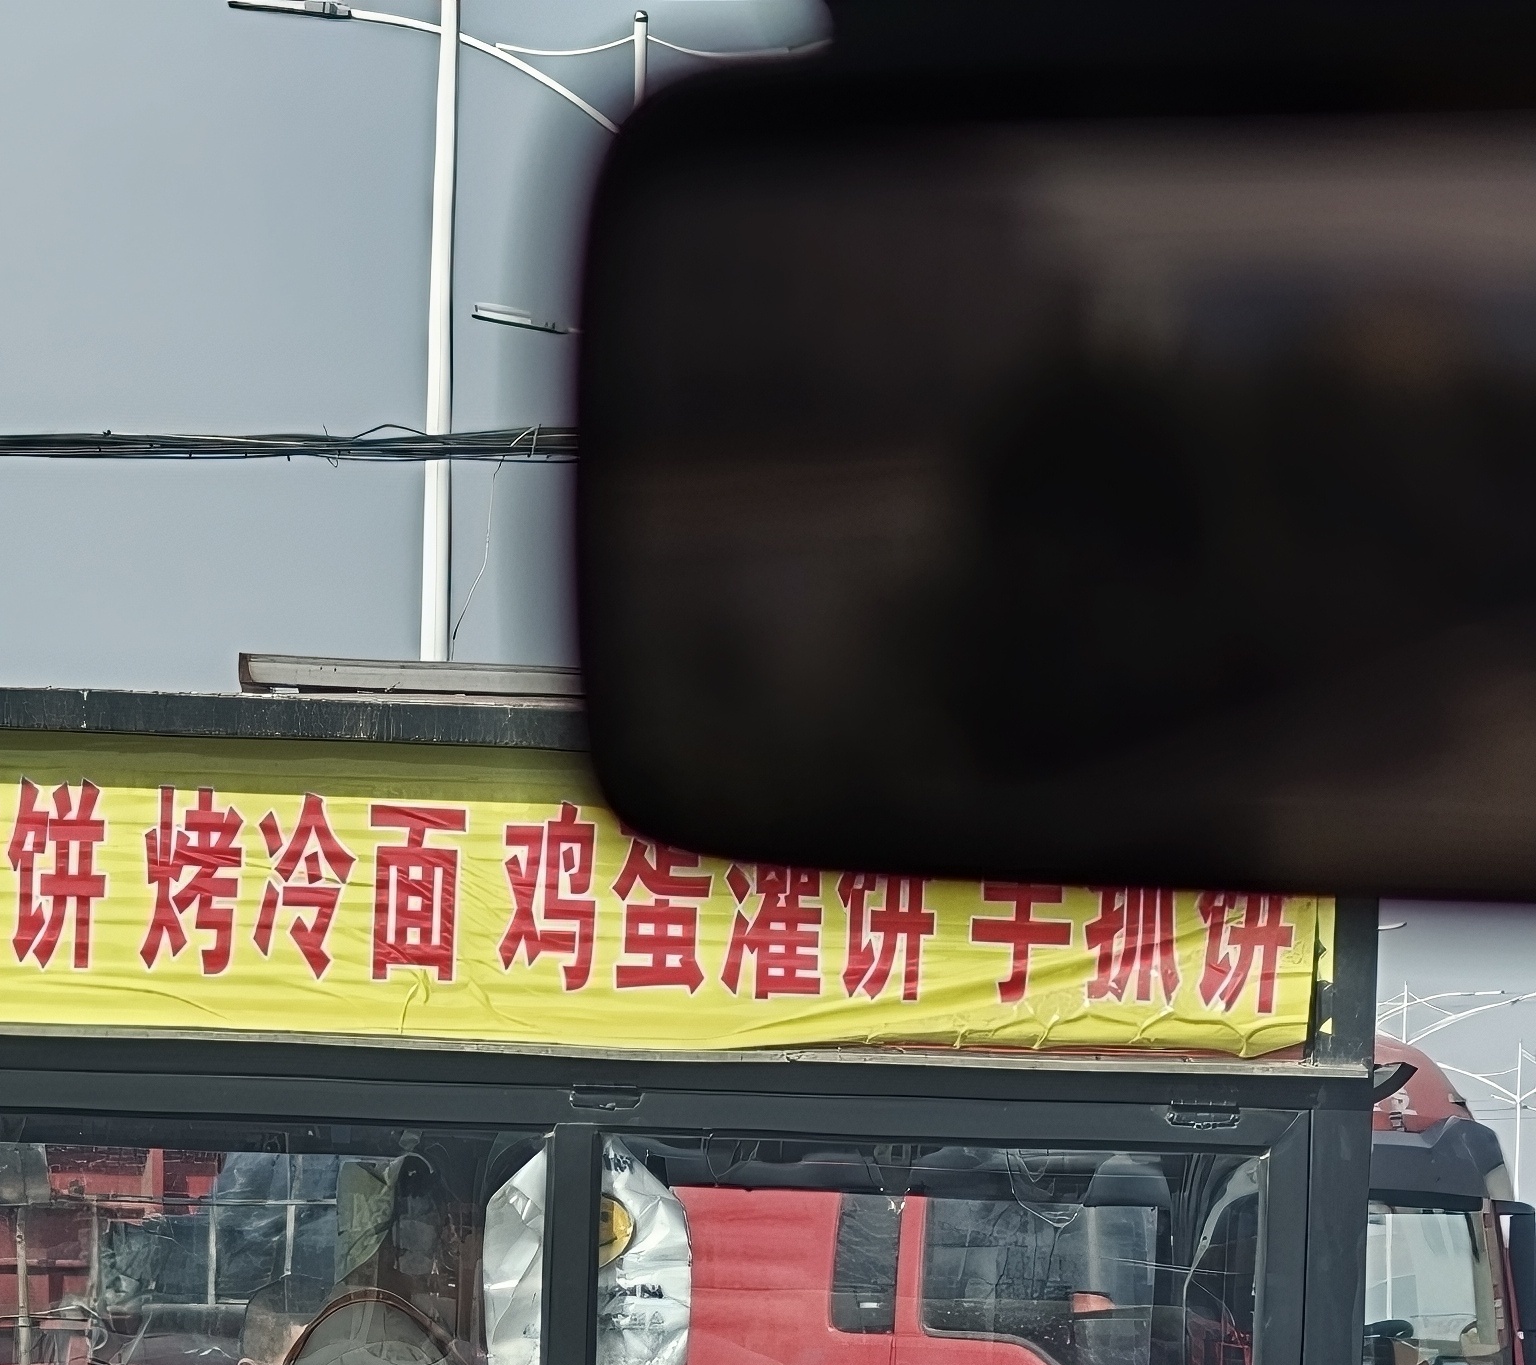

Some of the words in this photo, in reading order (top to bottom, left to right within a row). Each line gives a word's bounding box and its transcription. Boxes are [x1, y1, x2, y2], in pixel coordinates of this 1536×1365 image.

[139, 784, 467, 982] 烤冷面
[498, 802, 936, 1002] 鸡蛋灌饼
